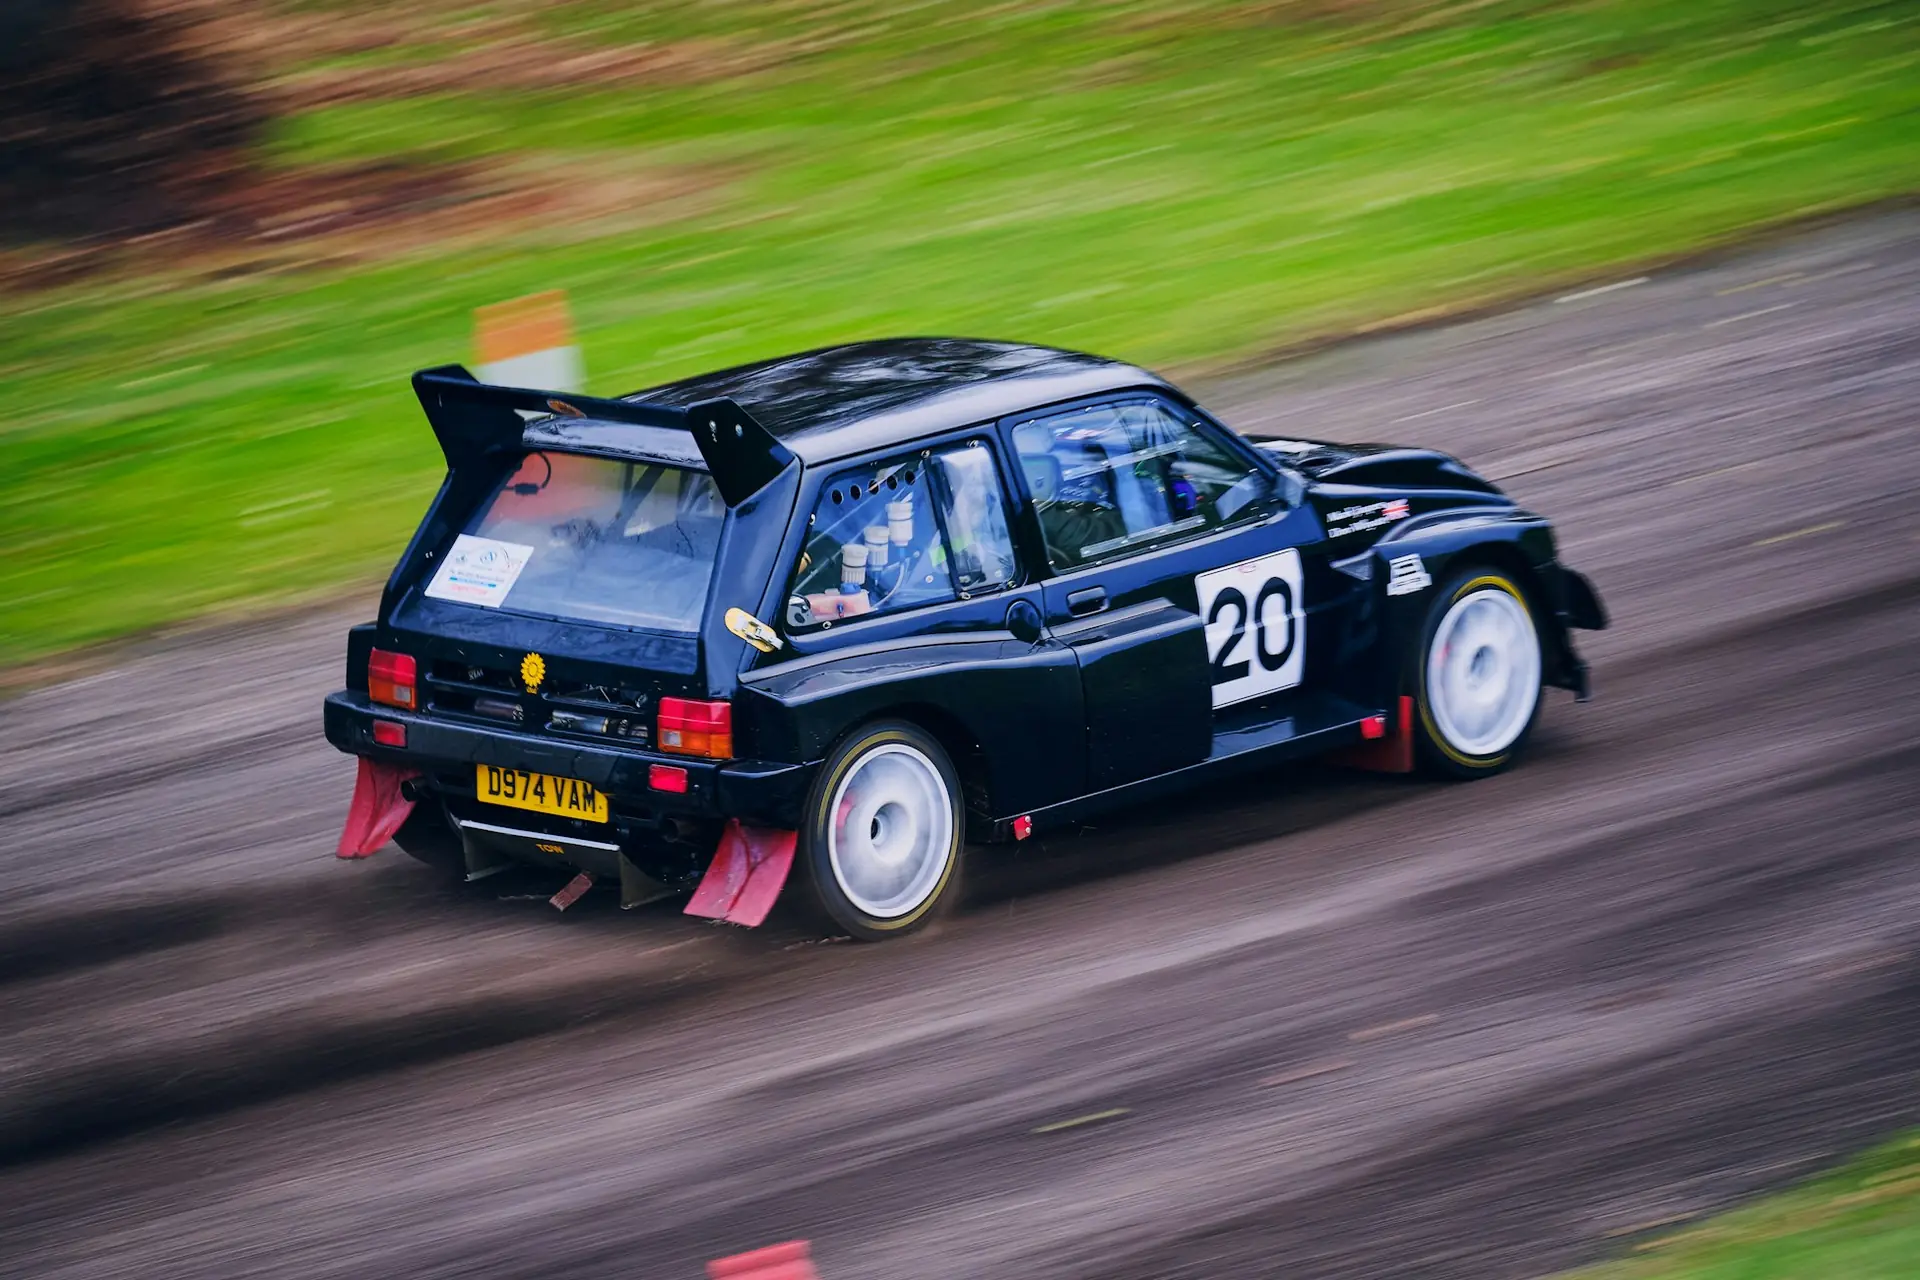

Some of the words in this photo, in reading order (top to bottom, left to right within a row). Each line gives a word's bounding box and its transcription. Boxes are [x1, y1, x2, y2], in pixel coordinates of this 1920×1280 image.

[1208, 577, 1295, 686] 20
[488, 766, 545, 804] D974
[553, 777, 596, 813] VAM
[535, 843, 565, 854] TOW
